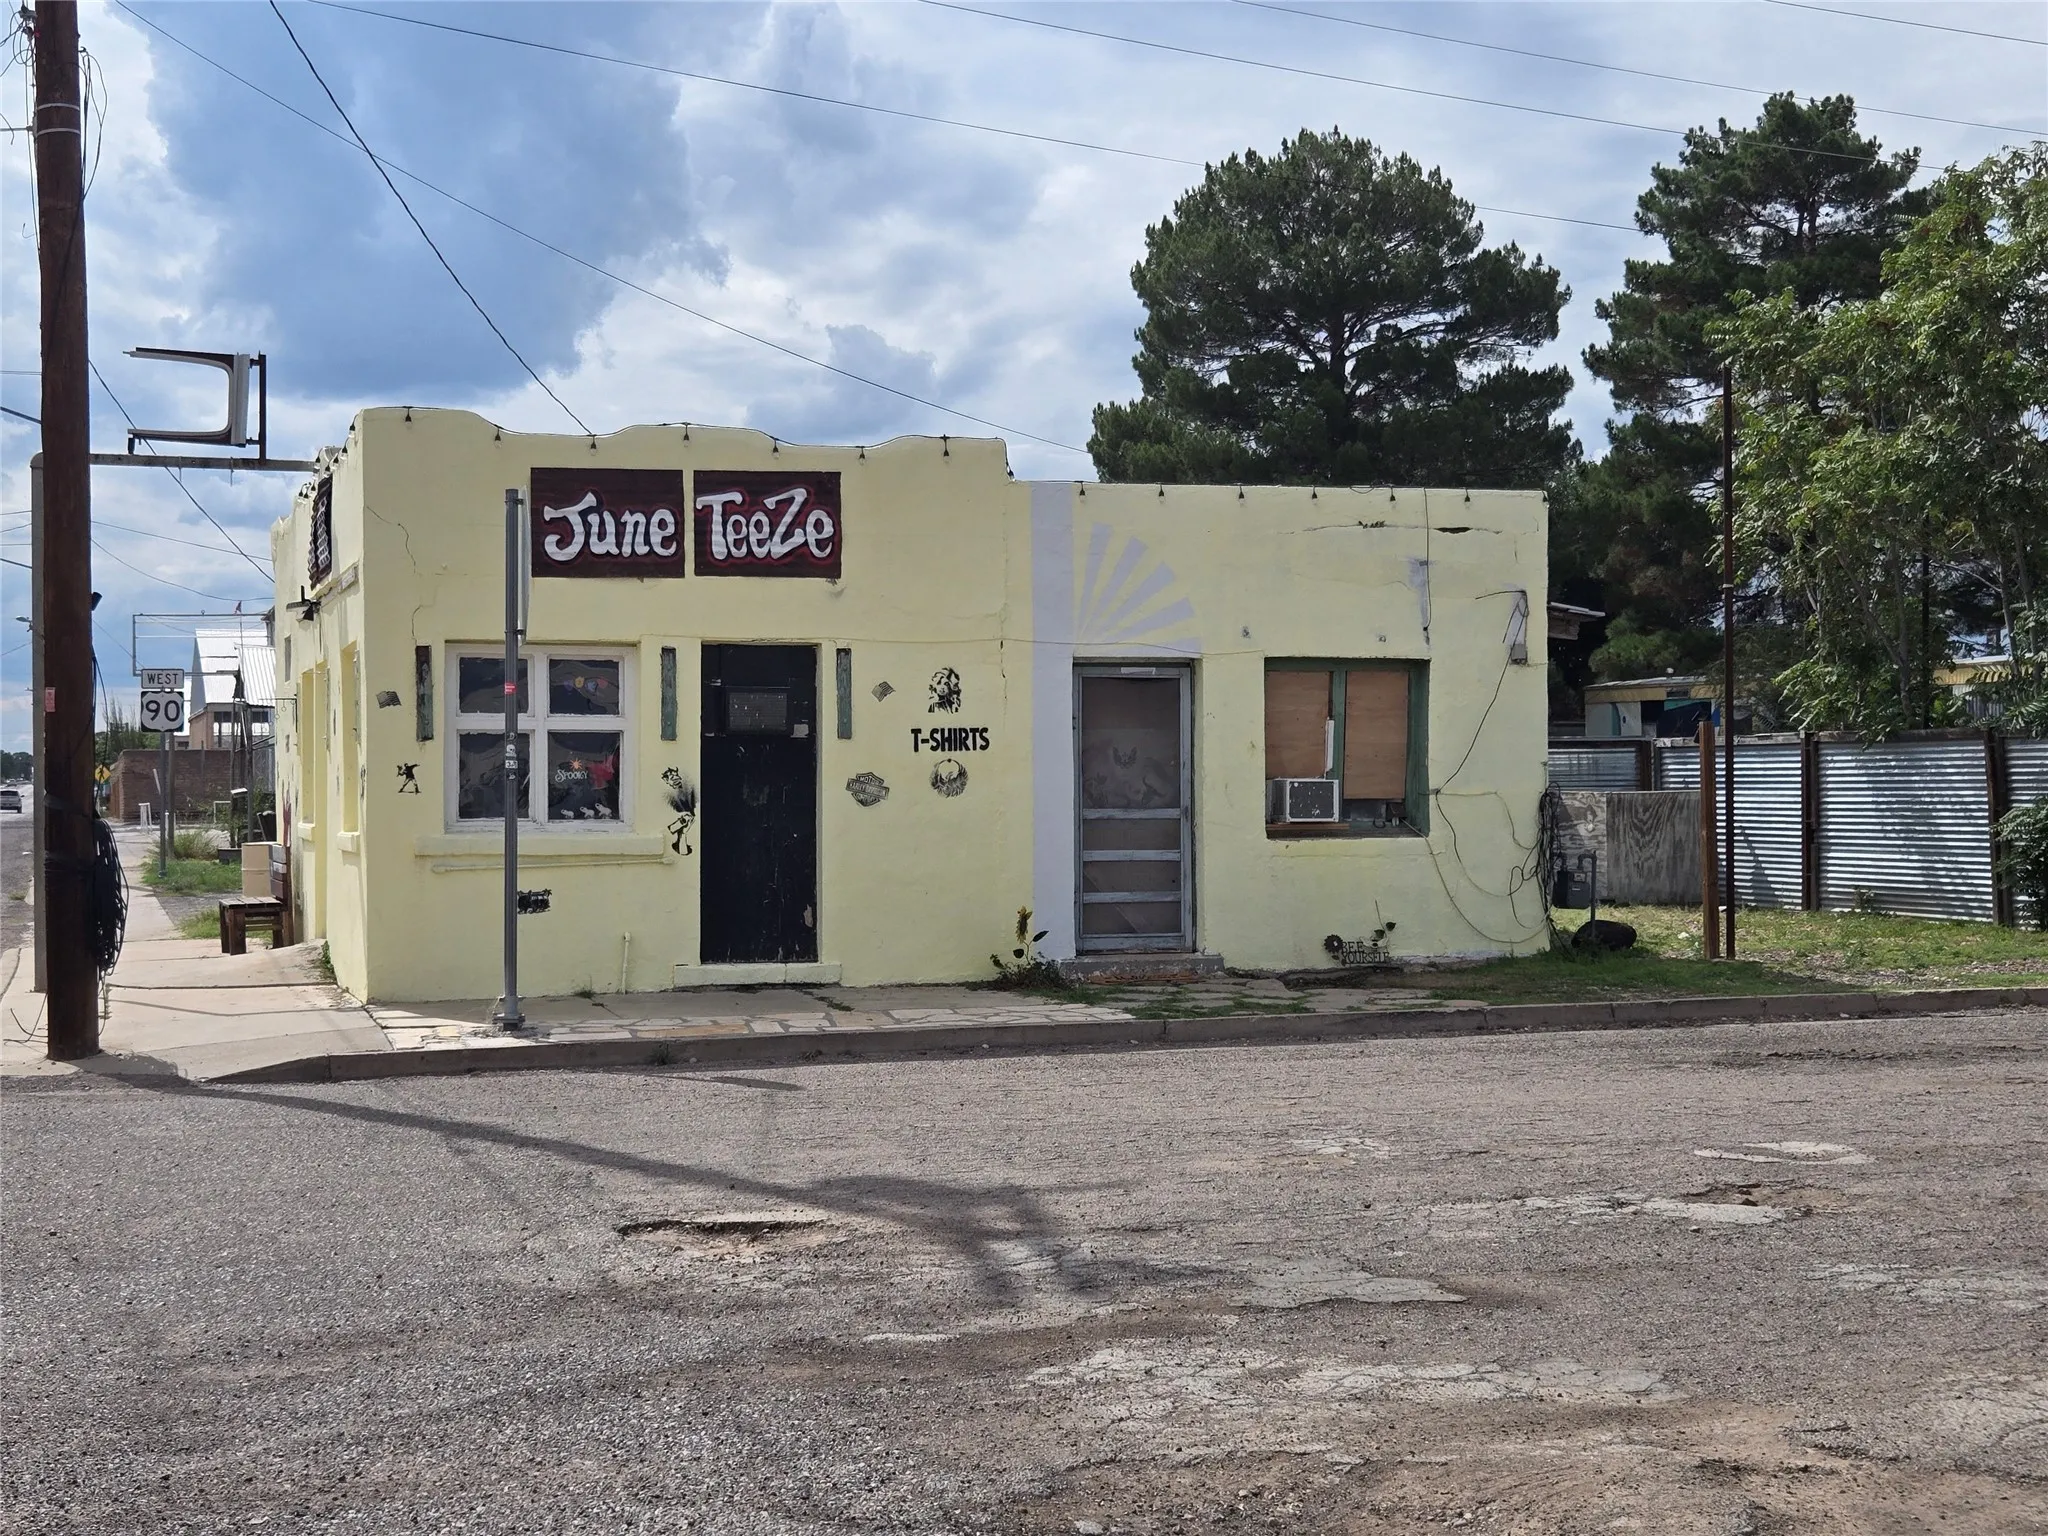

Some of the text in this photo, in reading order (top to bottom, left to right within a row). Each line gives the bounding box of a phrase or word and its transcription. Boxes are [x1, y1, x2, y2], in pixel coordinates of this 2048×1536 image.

[544, 487, 835, 562] June TeeZe
[146, 673, 179, 685] WEST
[145, 700, 181, 722] 90
[910, 727, 990, 753] T-SHIRTS
